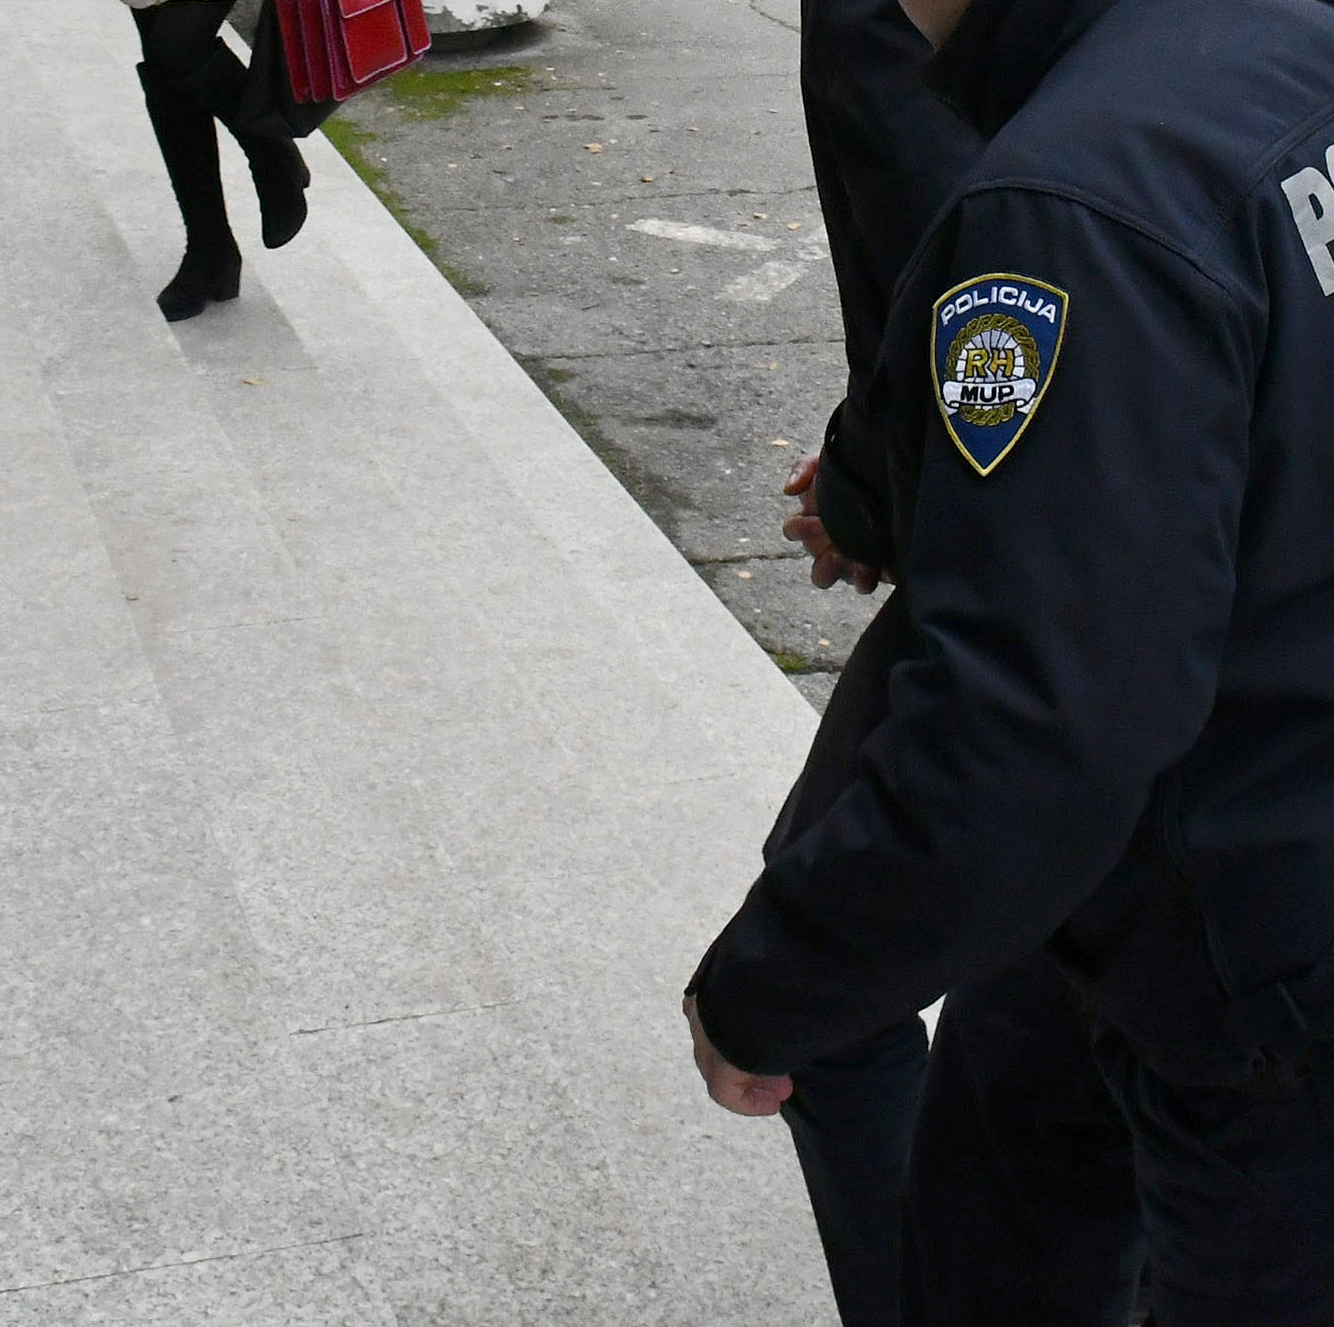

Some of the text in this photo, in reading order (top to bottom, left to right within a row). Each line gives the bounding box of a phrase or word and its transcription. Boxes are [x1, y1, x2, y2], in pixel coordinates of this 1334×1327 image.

[940, 285, 1058, 327] POLICIJA
[964, 347, 1016, 378] RH
[959, 384, 1015, 404] MUP
